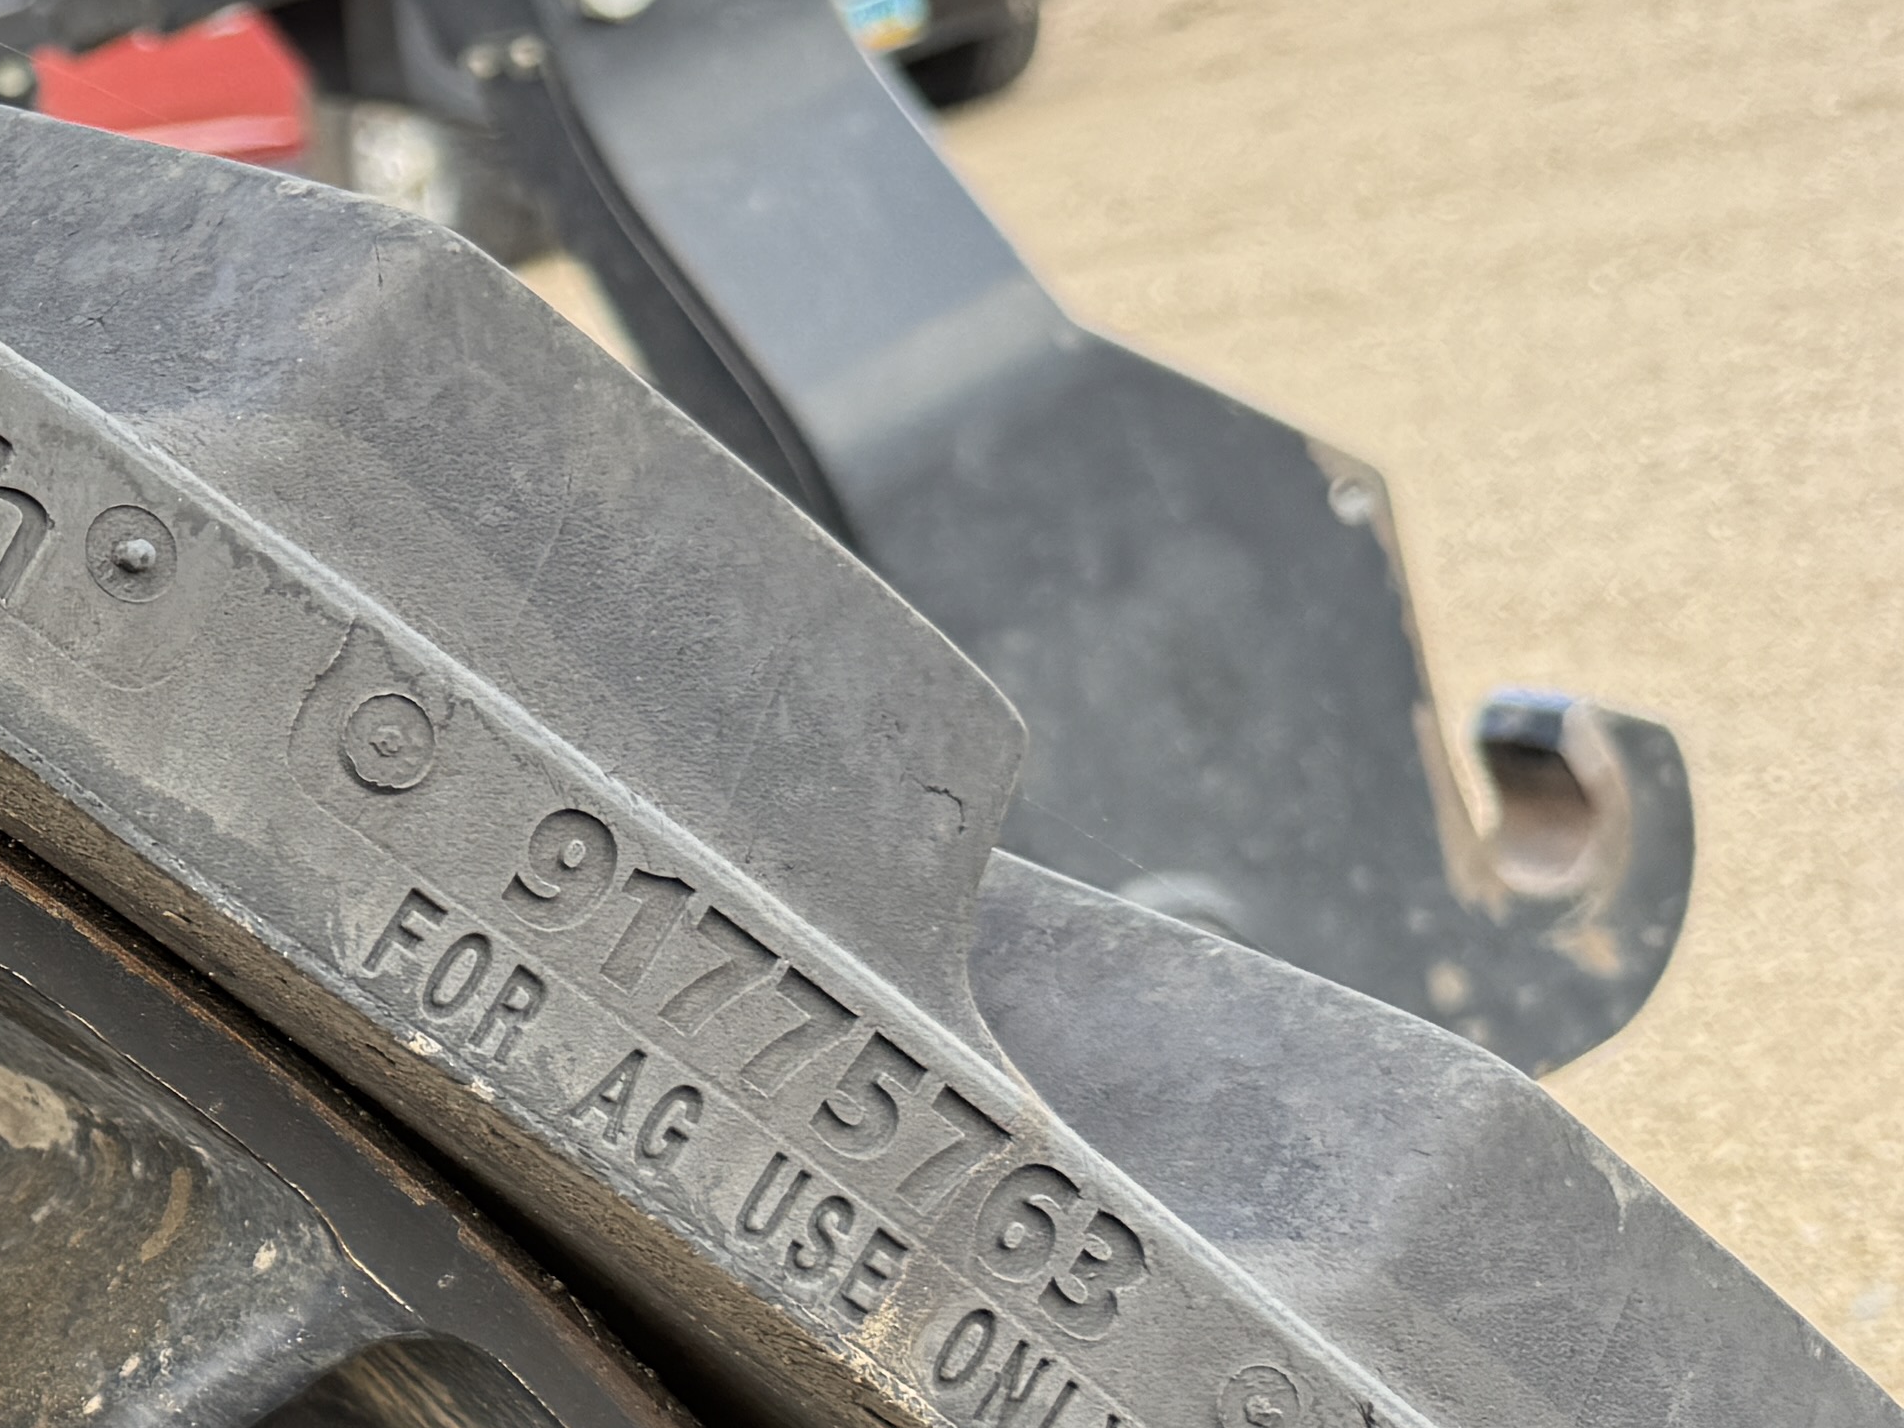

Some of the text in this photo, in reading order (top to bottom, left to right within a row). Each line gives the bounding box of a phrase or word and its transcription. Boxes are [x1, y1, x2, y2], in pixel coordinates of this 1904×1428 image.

[362, 887, 548, 1064] FOR
[570, 1048, 704, 1166] AG
[734, 1151, 912, 1318] USE
[501, 807, 1146, 1341] 91775763
